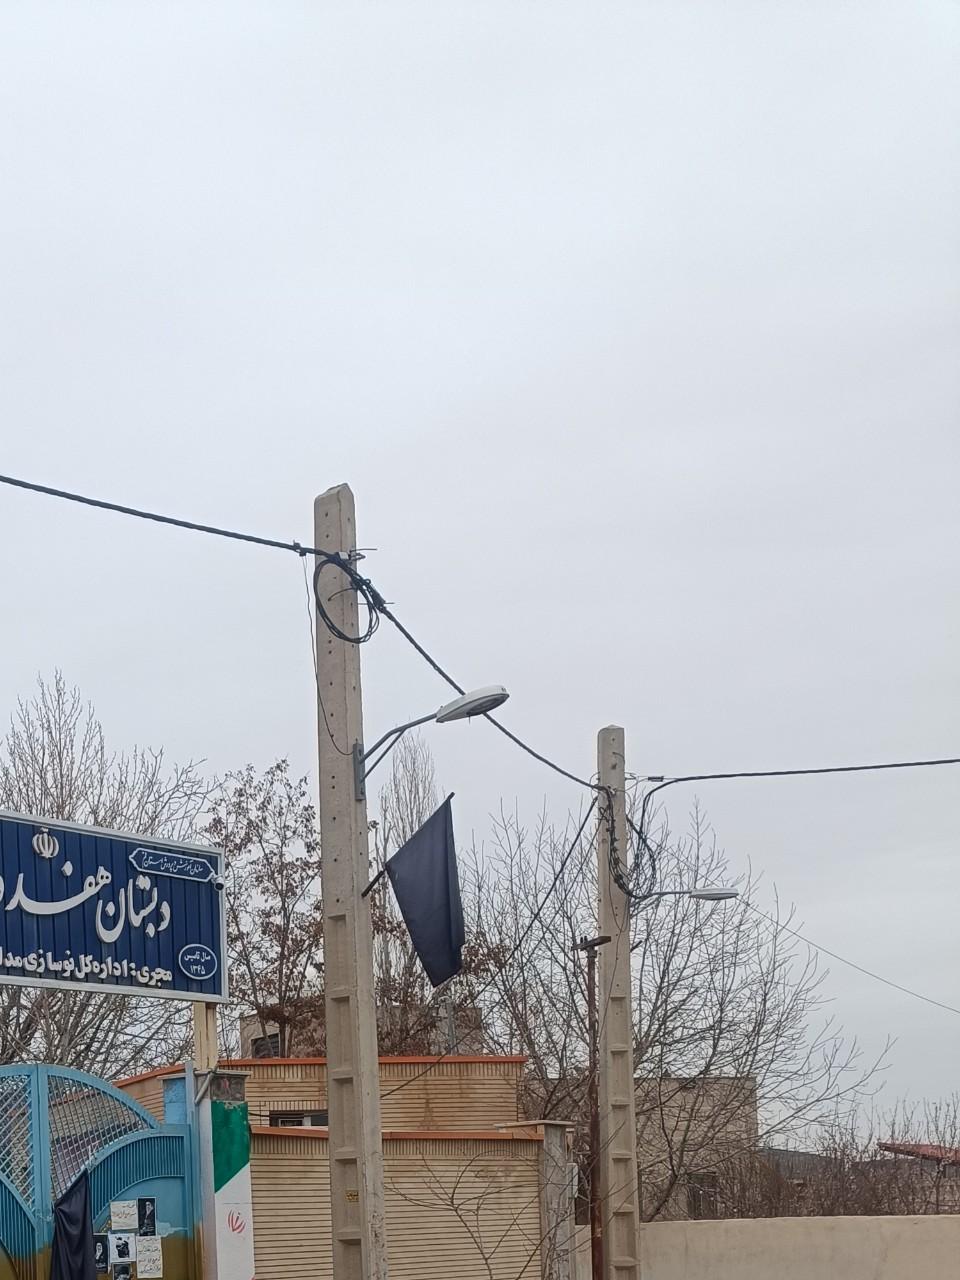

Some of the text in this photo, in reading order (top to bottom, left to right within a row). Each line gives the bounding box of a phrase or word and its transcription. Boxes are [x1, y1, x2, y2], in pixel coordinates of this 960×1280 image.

[173, 858, 194, 873] آموزش
[95, 874, 171, 943] دبستان
[24, 949, 75, 976] نوسازی
[75, 953, 93, 979] کل
[92, 956, 128, 979] اداره
[200, 951, 211, 962] سال
